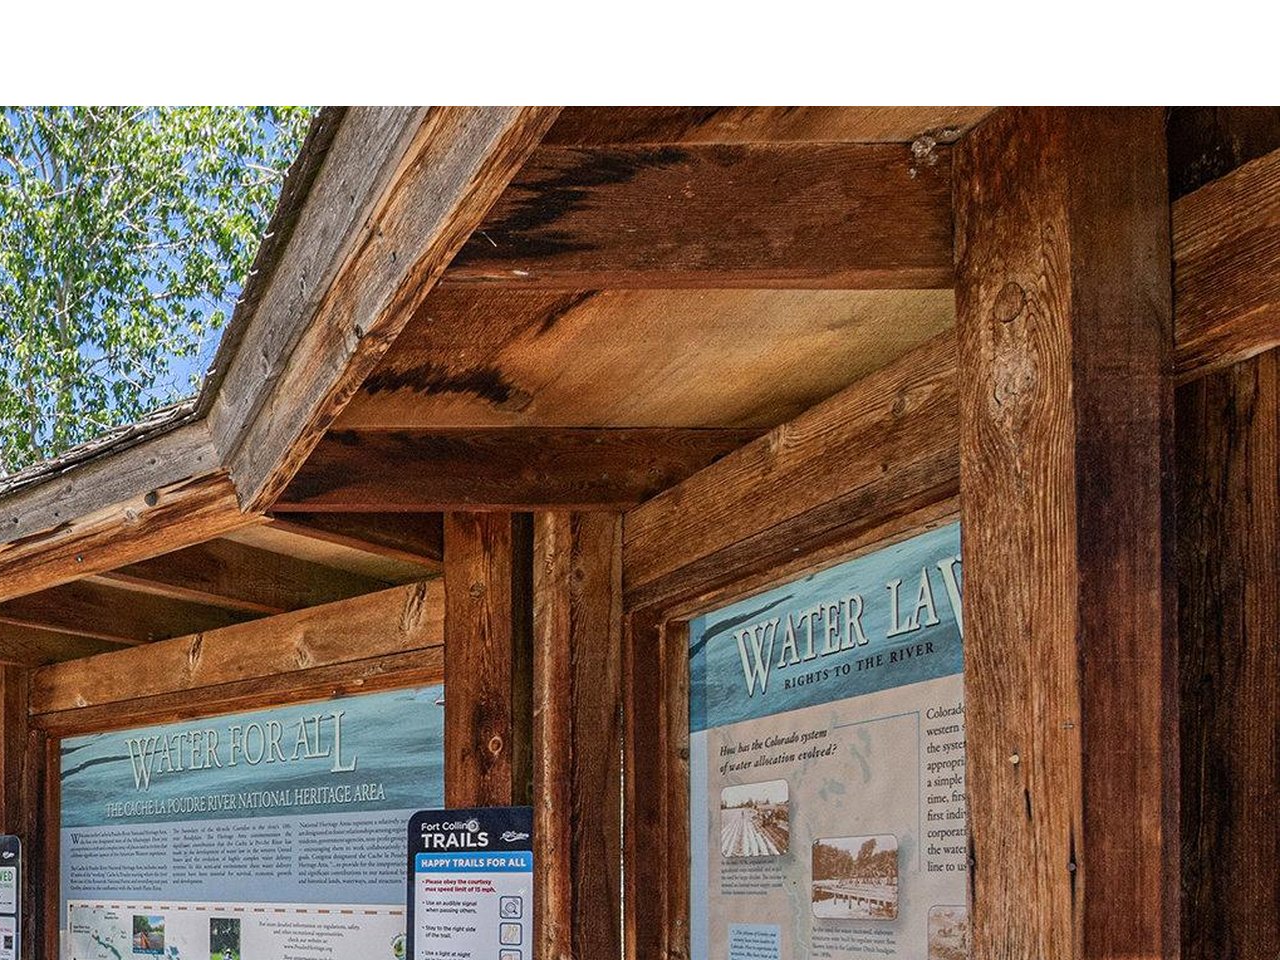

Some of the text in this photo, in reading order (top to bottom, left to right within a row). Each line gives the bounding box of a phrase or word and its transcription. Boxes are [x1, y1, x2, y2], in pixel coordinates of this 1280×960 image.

[731, 594, 869, 697] WATER
[784, 641, 935, 690] RIGHTS TO THE RIVER
[927, 724, 959, 737] western
[124, 709, 358, 791] WATER FOR ALL
[720, 730, 827, 756] How has the Colorado system
[927, 743, 940, 754] the
[720, 743, 837, 775] of water allocation evolved?
[934, 774, 963, 790] simple
[105, 783, 386, 817] THE CACHE LA POUDRE RIVER NATIONAL HERITAGE AREA
[927, 809, 944, 821] first
[421, 821, 469, 831] Fort Collin
[421, 832, 489, 848] TRAILS
[927, 844, 941, 855] the
[421, 858, 527, 868] HAPPY TRAILS FOR ALL
[927, 861, 954, 872] line to
